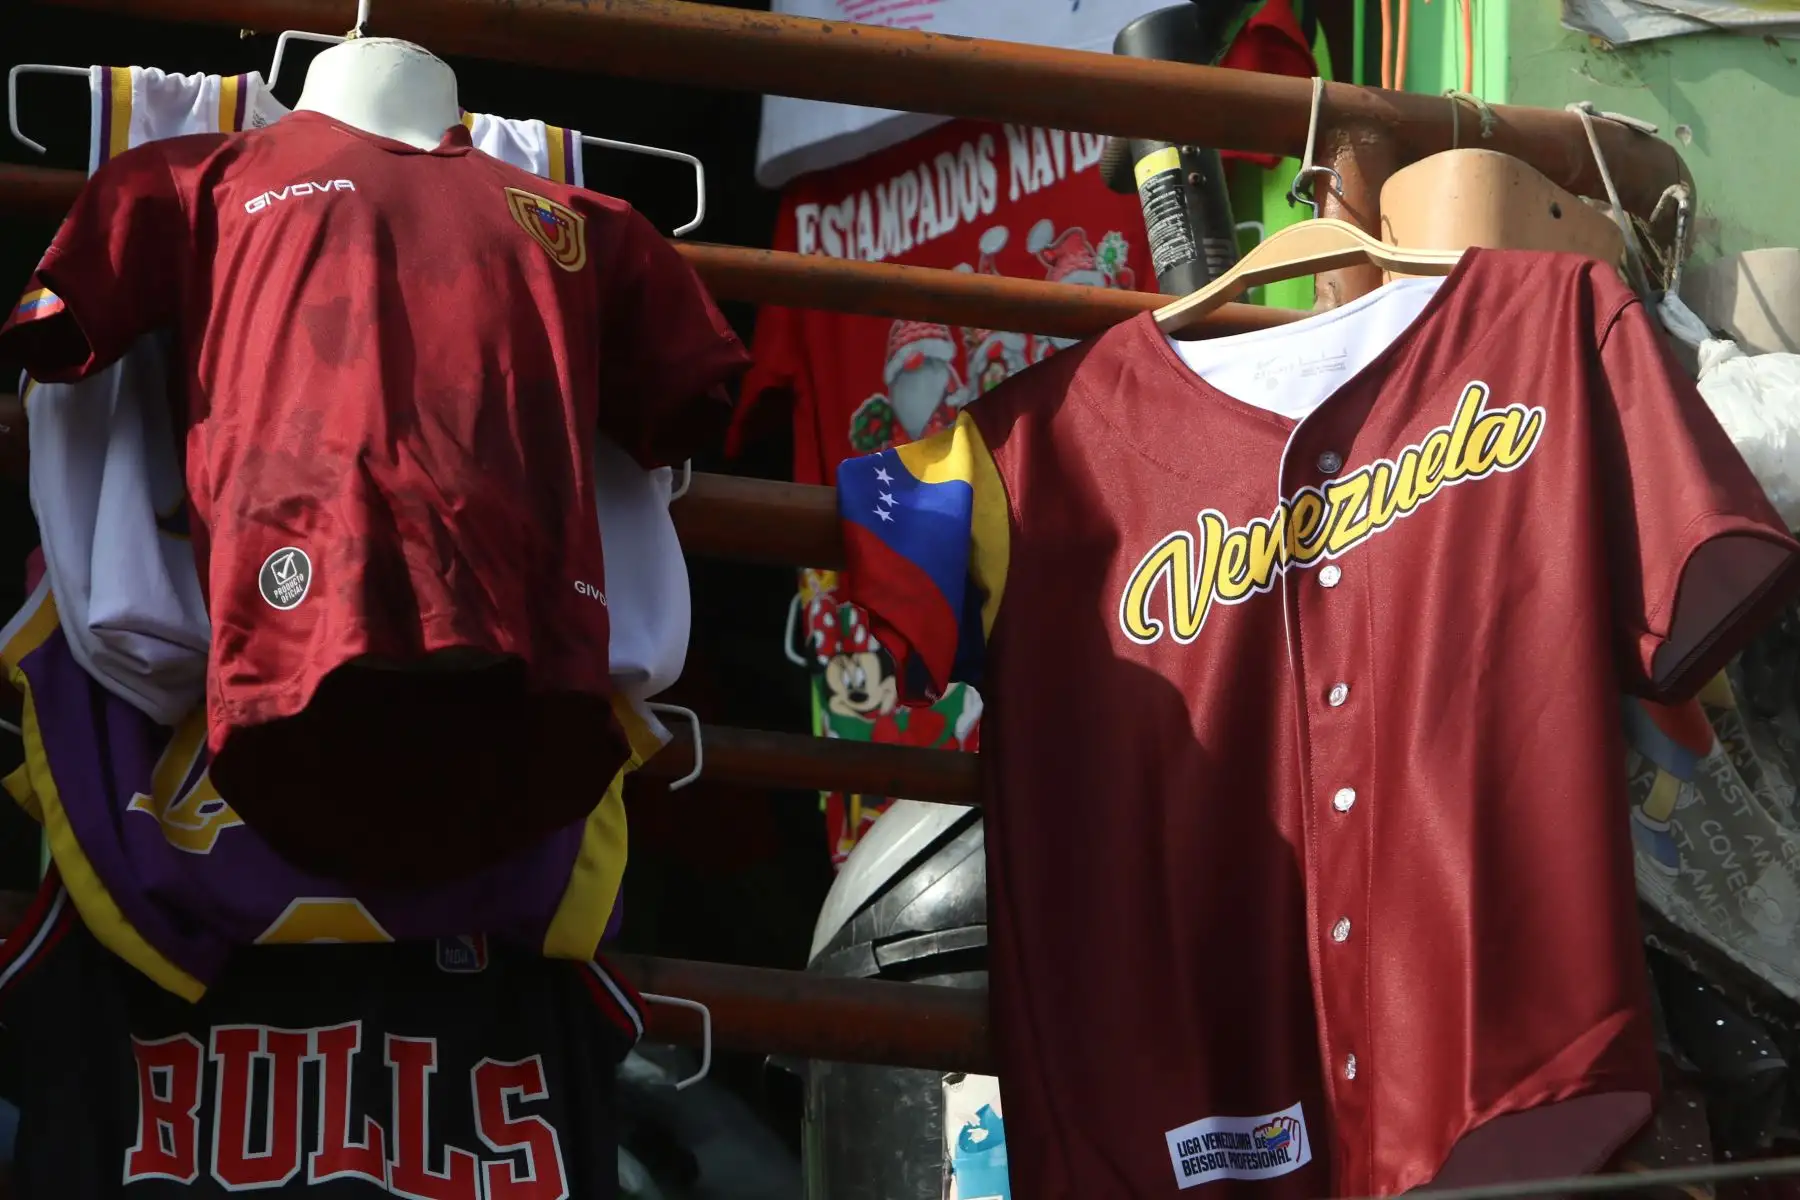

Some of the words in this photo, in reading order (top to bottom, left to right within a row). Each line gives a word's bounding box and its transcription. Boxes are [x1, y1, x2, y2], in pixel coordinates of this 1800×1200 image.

[244, 179, 356, 214] GIVOVA
[795, 133, 998, 263] ESTAMPADOS
[1119, 380, 1547, 645] Venezuela
[273, 573, 304, 599] PRODUCTO
[281, 584, 303, 604] OFICIAL
[122, 1019, 570, 1200] BULLS
[1177, 1137, 1202, 1158] LIGA
[1181, 1149, 1230, 1177] BEISBOL
[1229, 1146, 1292, 1171] PROFESIONAL
